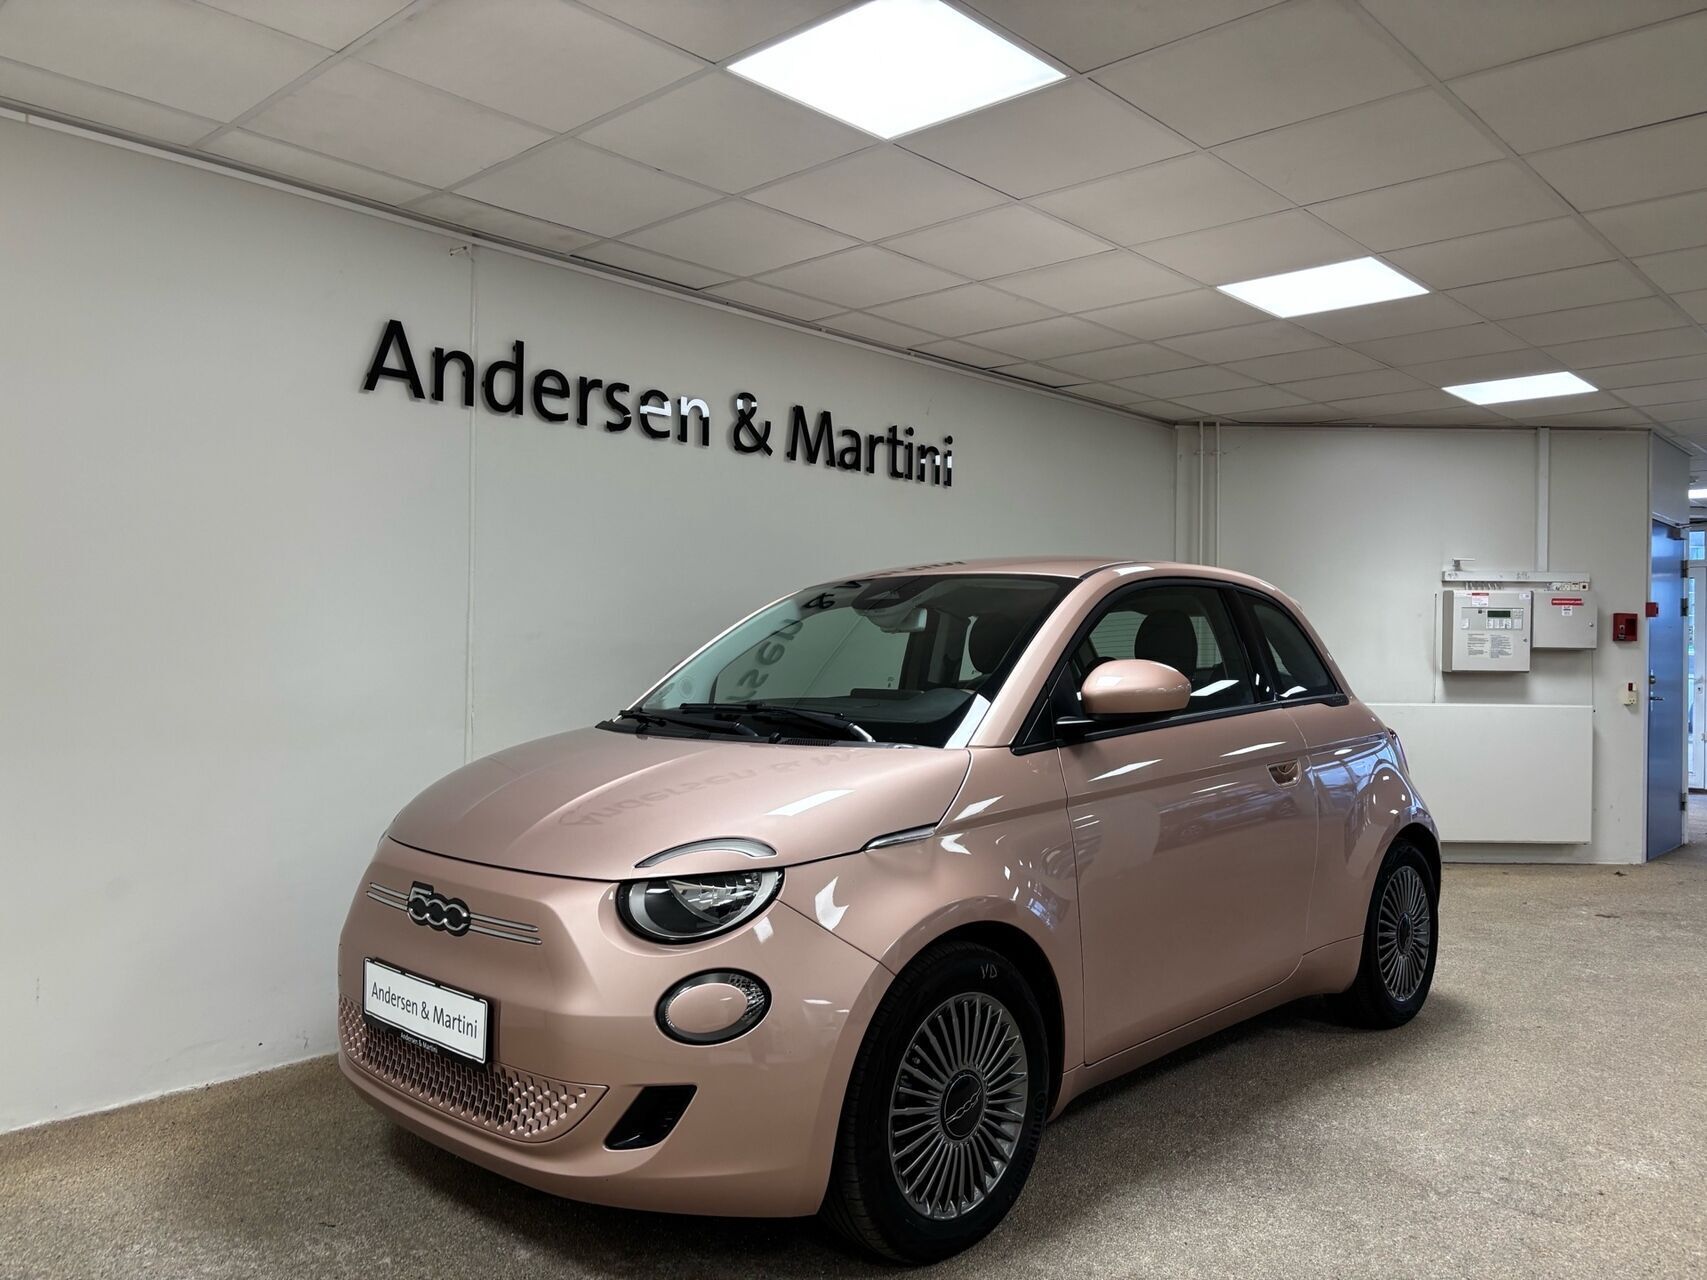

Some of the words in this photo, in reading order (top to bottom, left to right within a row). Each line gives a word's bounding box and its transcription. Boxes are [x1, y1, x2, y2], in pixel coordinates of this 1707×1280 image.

[363, 319, 710, 447] Andersen
[732, 391, 773, 457] &
[786, 404, 953, 488] Martini
[406, 880, 472, 937] 500
[371, 981, 418, 1016] Andersen
[421, 1001, 430, 1020] &
[433, 1005, 478, 1039] Martini
